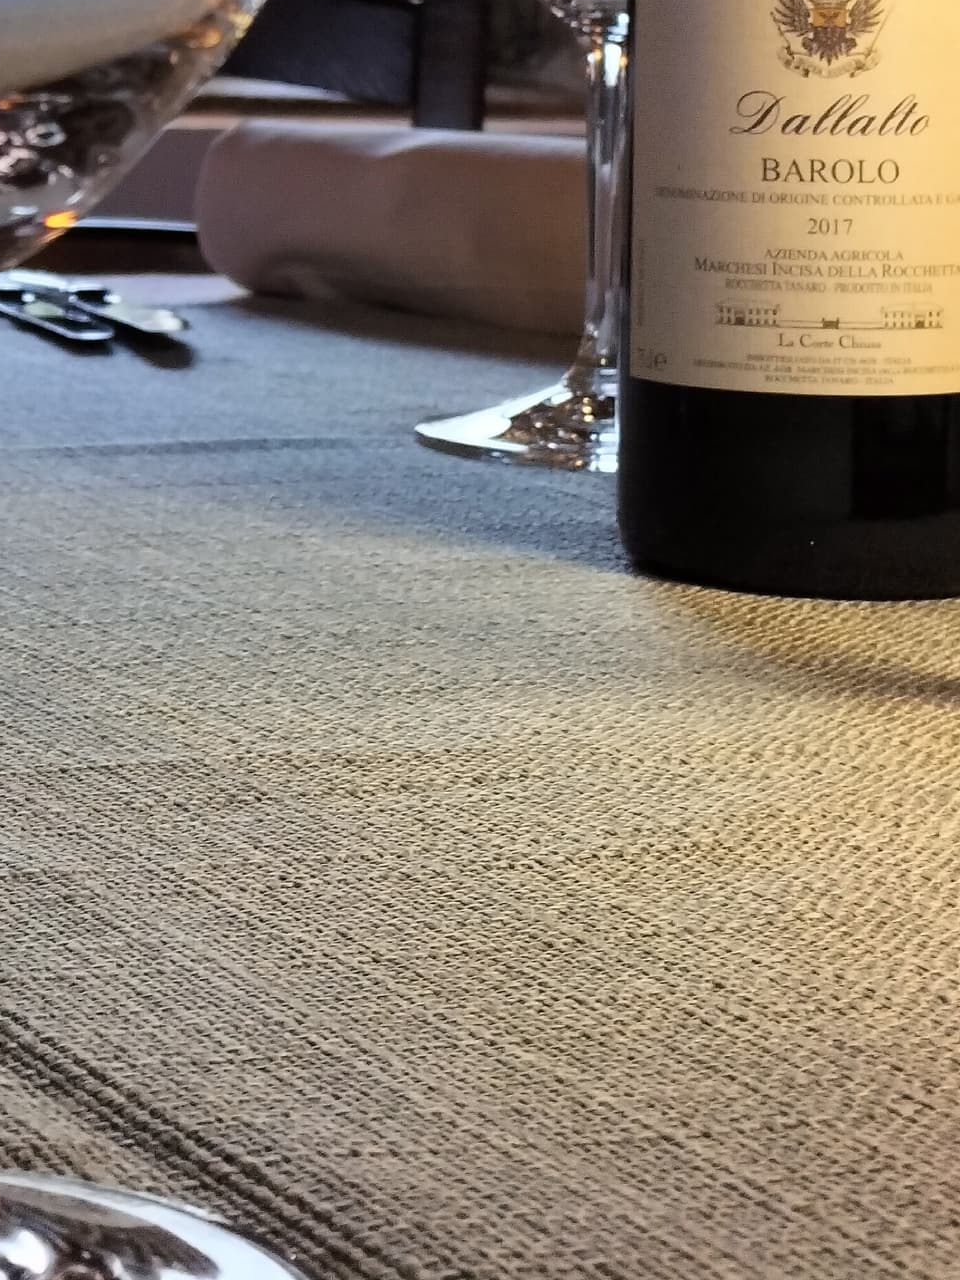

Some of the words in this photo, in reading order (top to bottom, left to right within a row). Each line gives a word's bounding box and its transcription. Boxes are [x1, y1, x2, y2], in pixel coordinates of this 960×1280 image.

[729, 90, 930, 136] Dallalto
[761, 157, 900, 184] BAROLO
[751, 191, 766, 204] DI
[769, 192, 828, 206] ORIGINE
[832, 193, 933, 206] CONTROLLATA
[807, 218, 854, 236] 2017
[764, 248, 827, 261] AZIENDA
[830, 250, 904, 261] AGRICOLA
